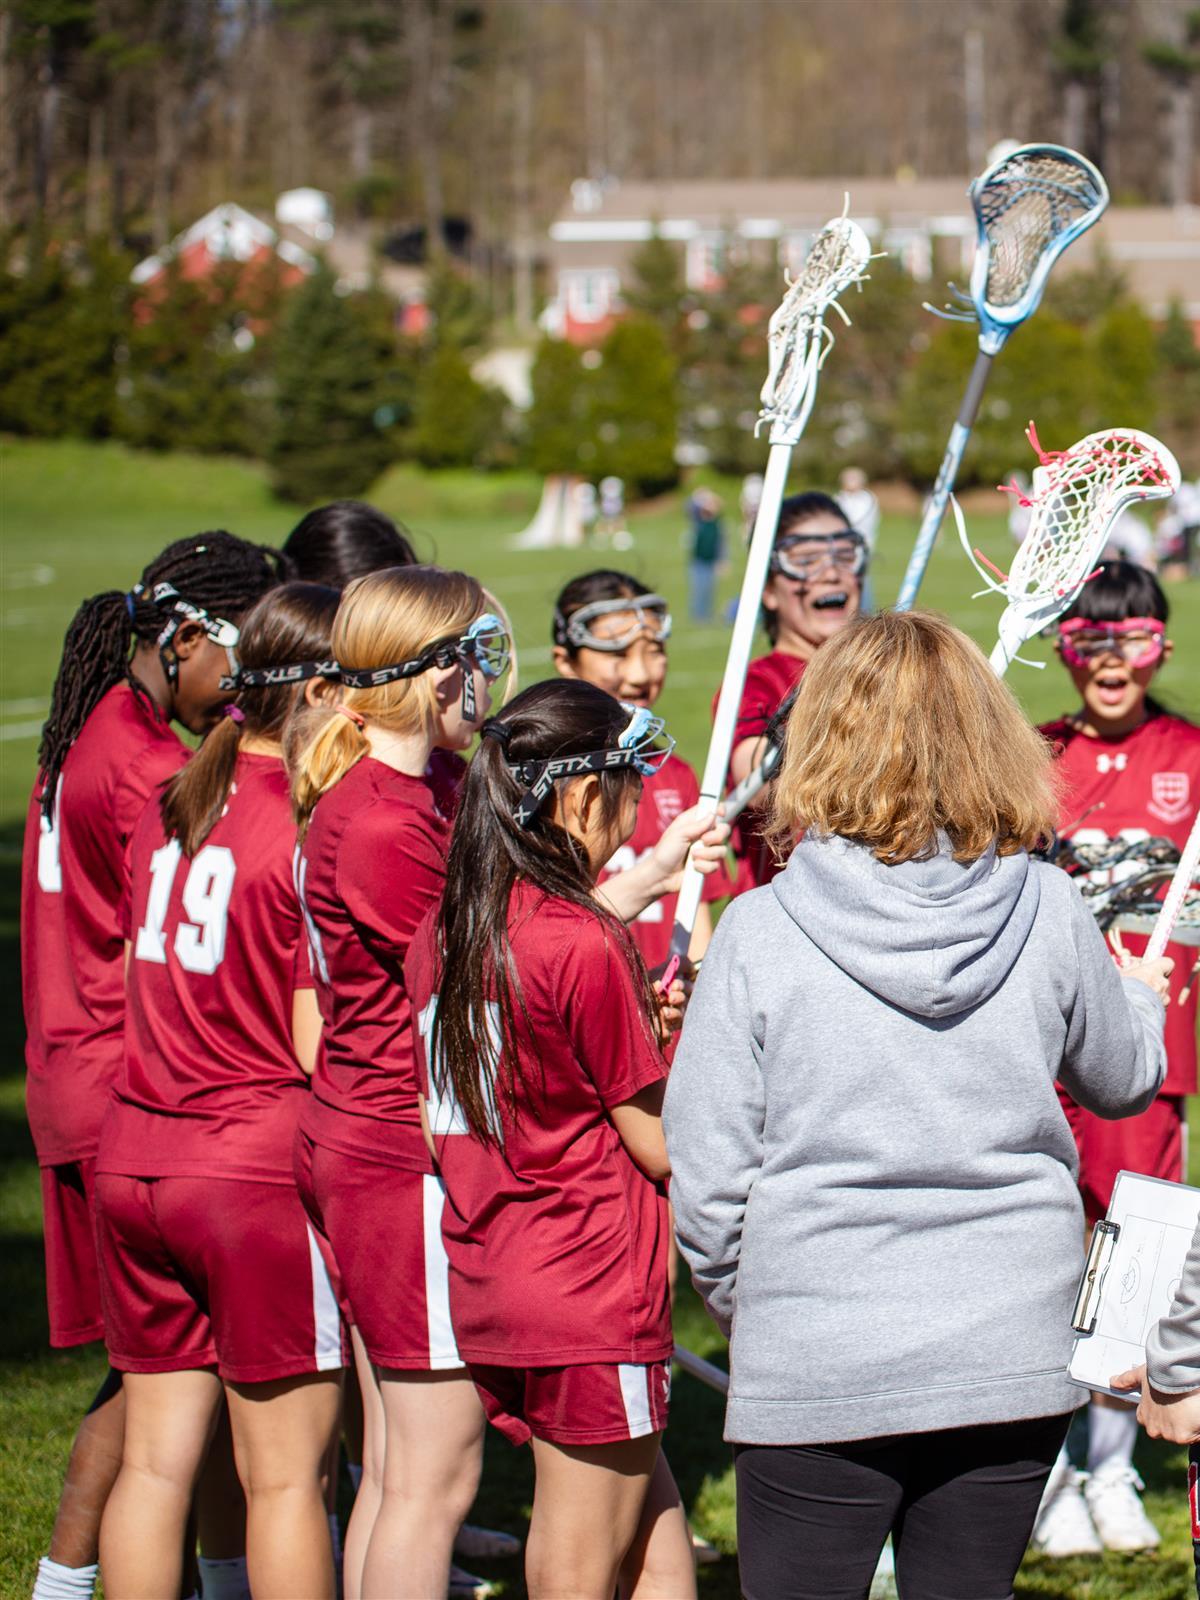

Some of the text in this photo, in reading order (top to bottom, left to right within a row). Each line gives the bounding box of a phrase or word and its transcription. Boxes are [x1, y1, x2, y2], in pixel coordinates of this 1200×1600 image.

[263, 665, 304, 684] STX
[314, 660, 340, 675] TX
[464, 671, 476, 716] STX
[547, 754, 593, 775] STX
[604, 749, 634, 766] ST
[135, 836, 236, 976] 19
